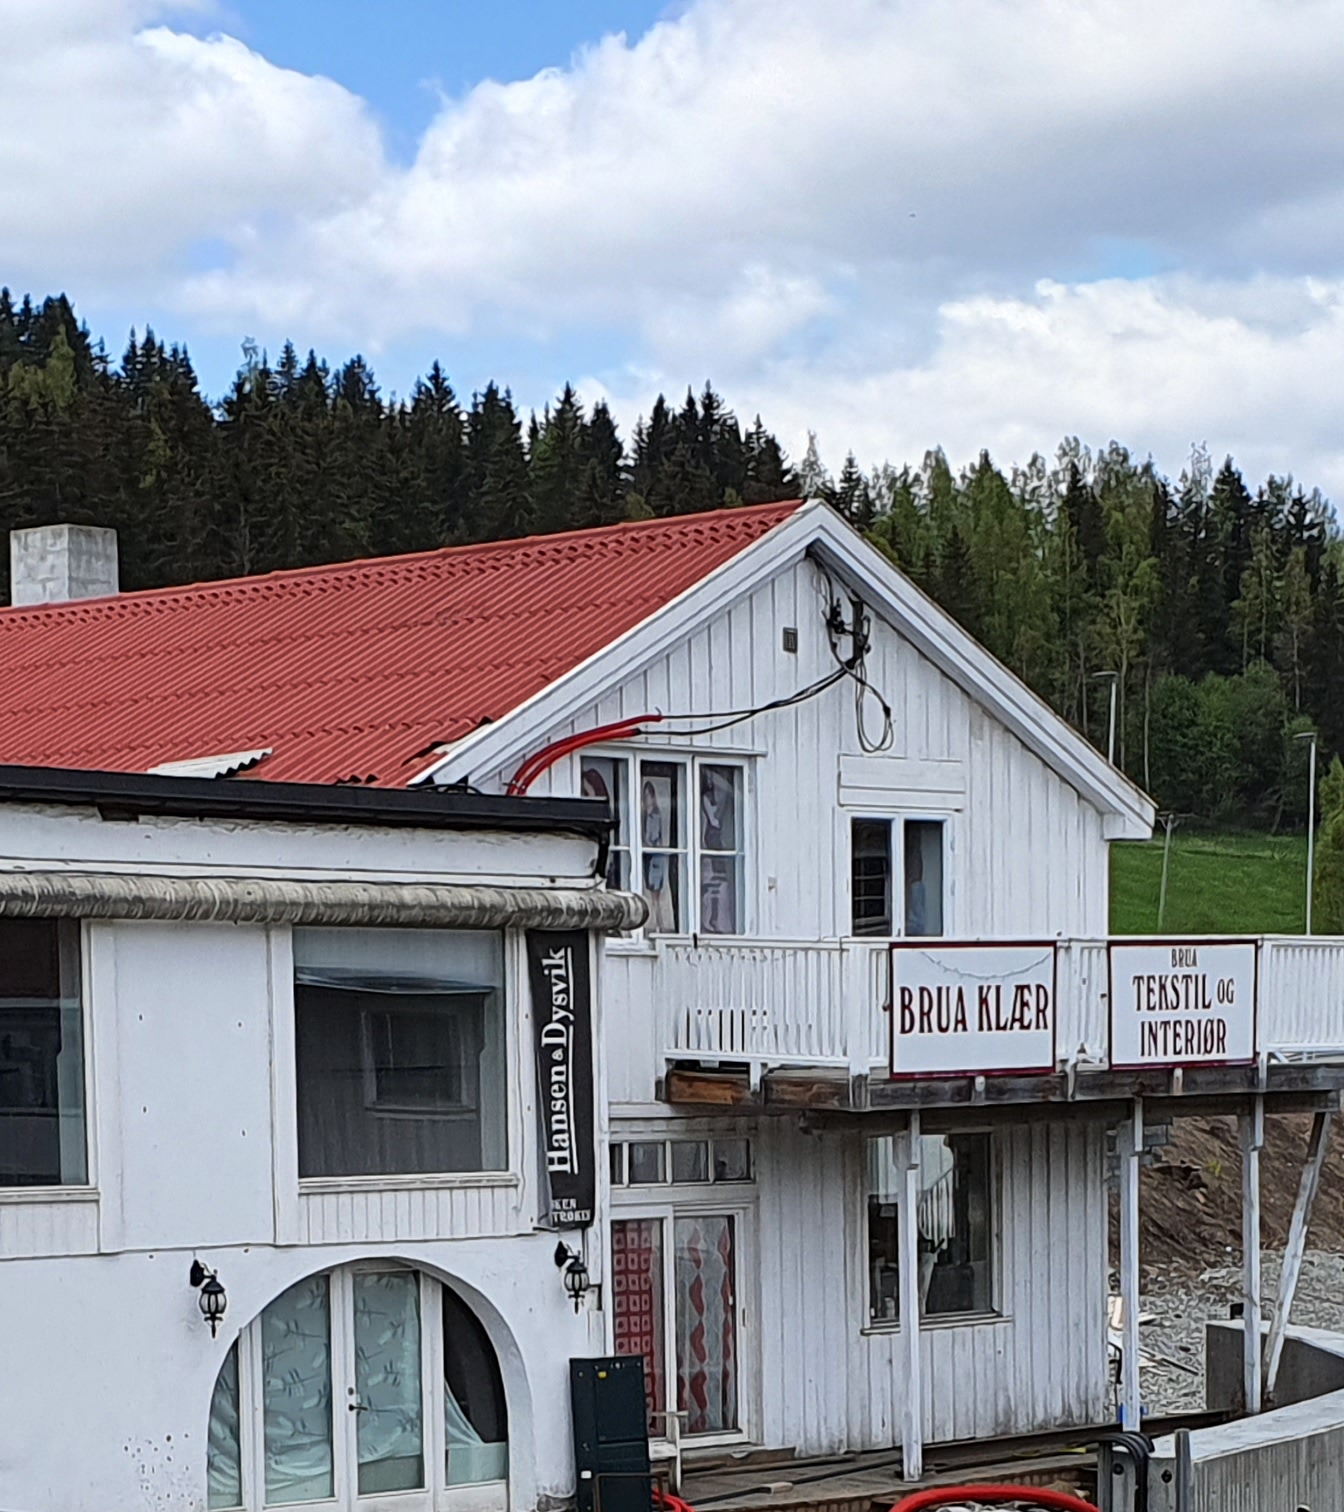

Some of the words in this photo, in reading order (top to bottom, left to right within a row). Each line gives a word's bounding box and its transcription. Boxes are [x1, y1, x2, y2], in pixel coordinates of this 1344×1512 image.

[1171, 948, 1198, 968] BRUA
[541, 947, 575, 1048] Dysvik
[899, 984, 966, 1034] BRUA
[977, 982, 1049, 1032] KLÆR
[1132, 973, 1212, 1012] TEKSTIL
[1217, 978, 1235, 1004] OG
[1140, 1017, 1227, 1057] INTERIØR
[547, 1064, 571, 1174] Hansen
